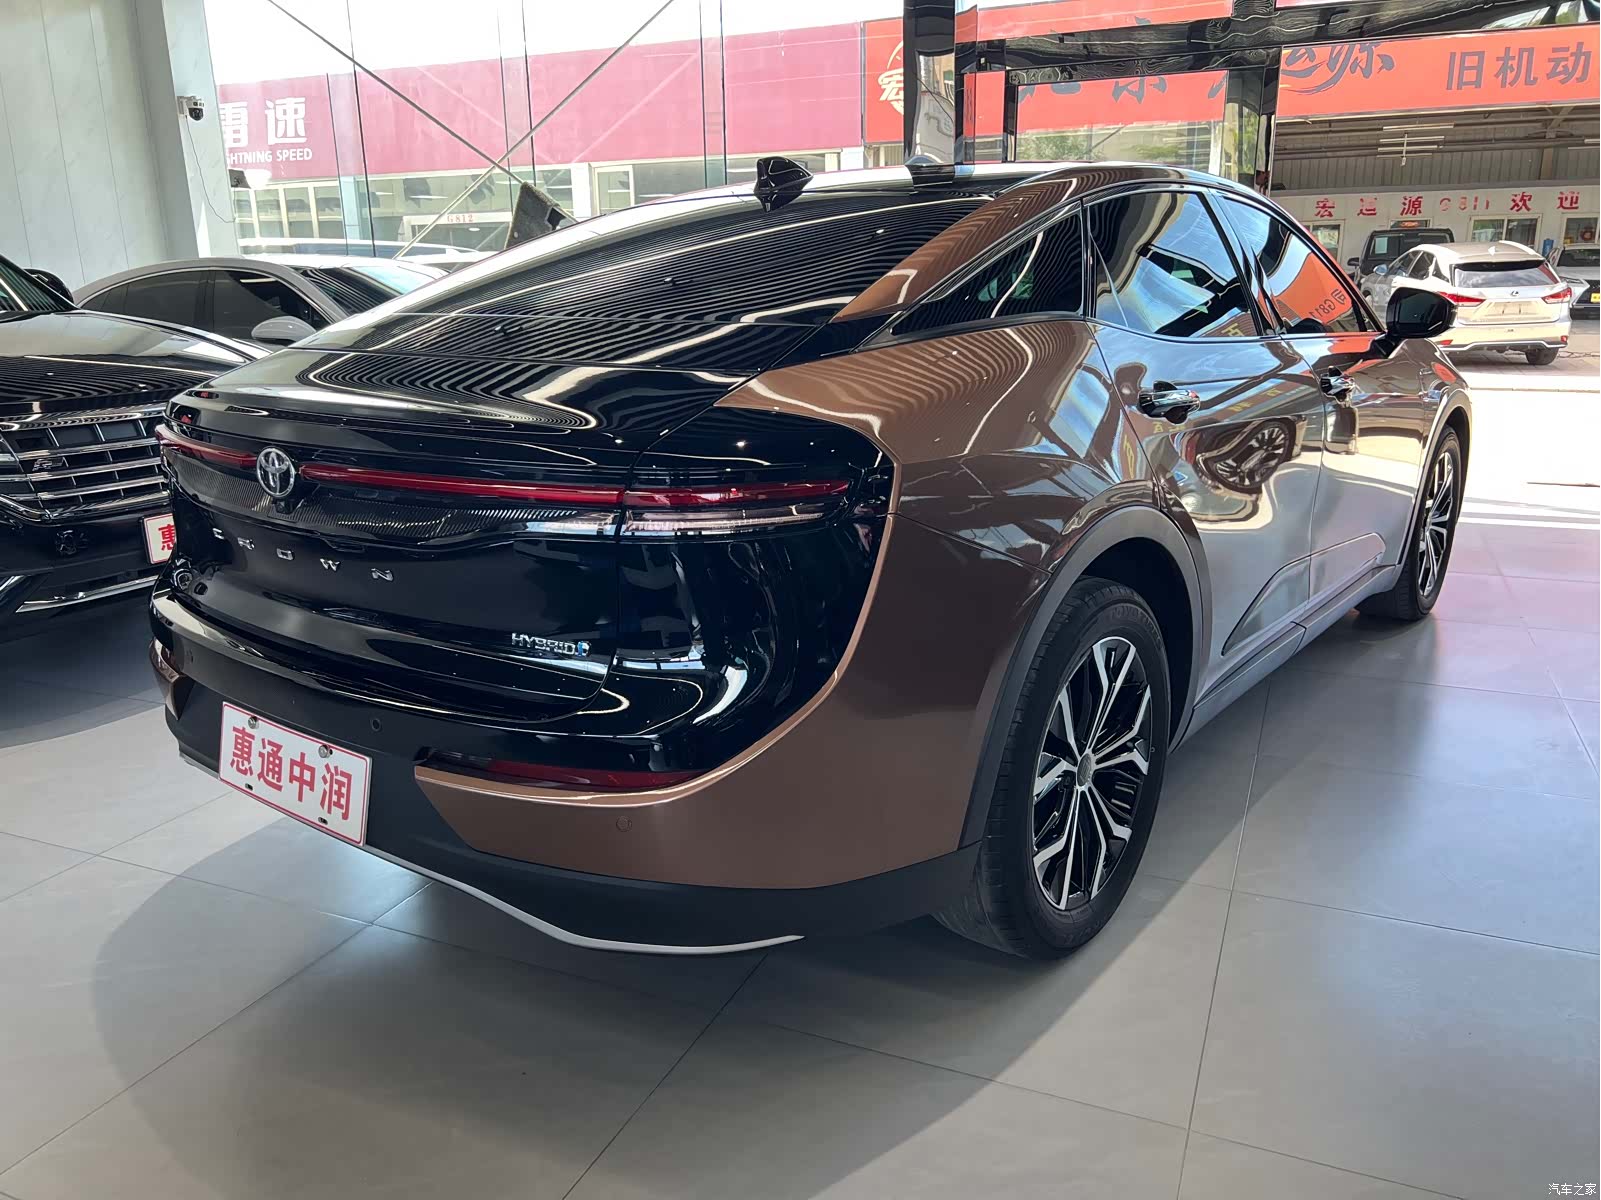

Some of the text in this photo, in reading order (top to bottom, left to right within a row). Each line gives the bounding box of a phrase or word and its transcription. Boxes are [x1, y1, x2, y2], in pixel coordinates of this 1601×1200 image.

[1446, 42, 1592, 91] 旧机动
[276, 147, 313, 162] SPEED
[447, 214, 474, 223] G812
[212, 527, 394, 582] CROWN
[511, 632, 576, 655] HYBRID
[230, 725, 353, 821] 惠通中润
